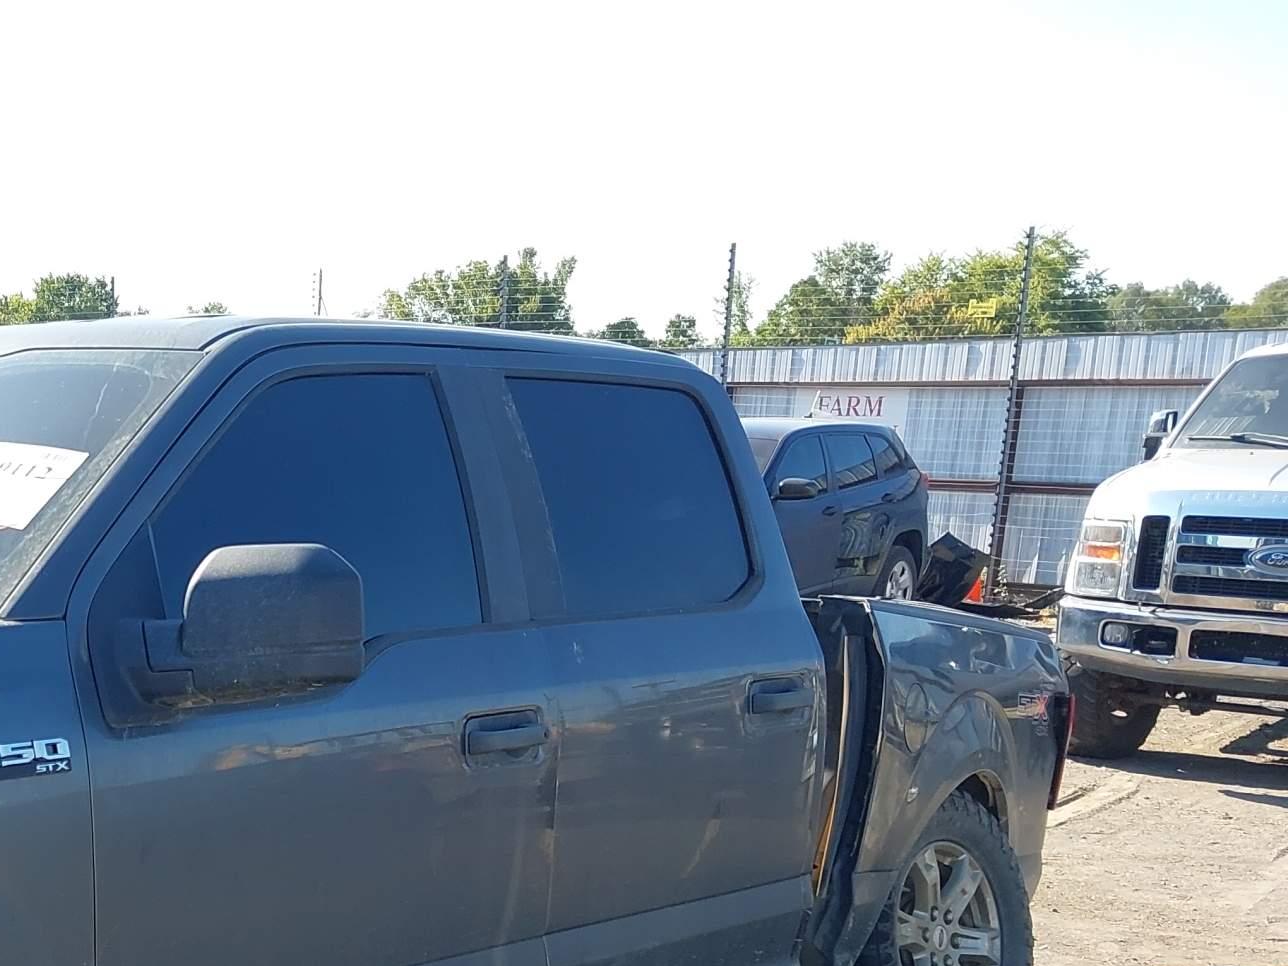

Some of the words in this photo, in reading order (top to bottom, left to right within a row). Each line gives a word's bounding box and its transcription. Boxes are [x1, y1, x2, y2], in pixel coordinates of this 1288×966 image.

[818, 395, 886, 417] FARM
[1266, 552, 1288, 566] For
[35, 760, 70, 774] STX
